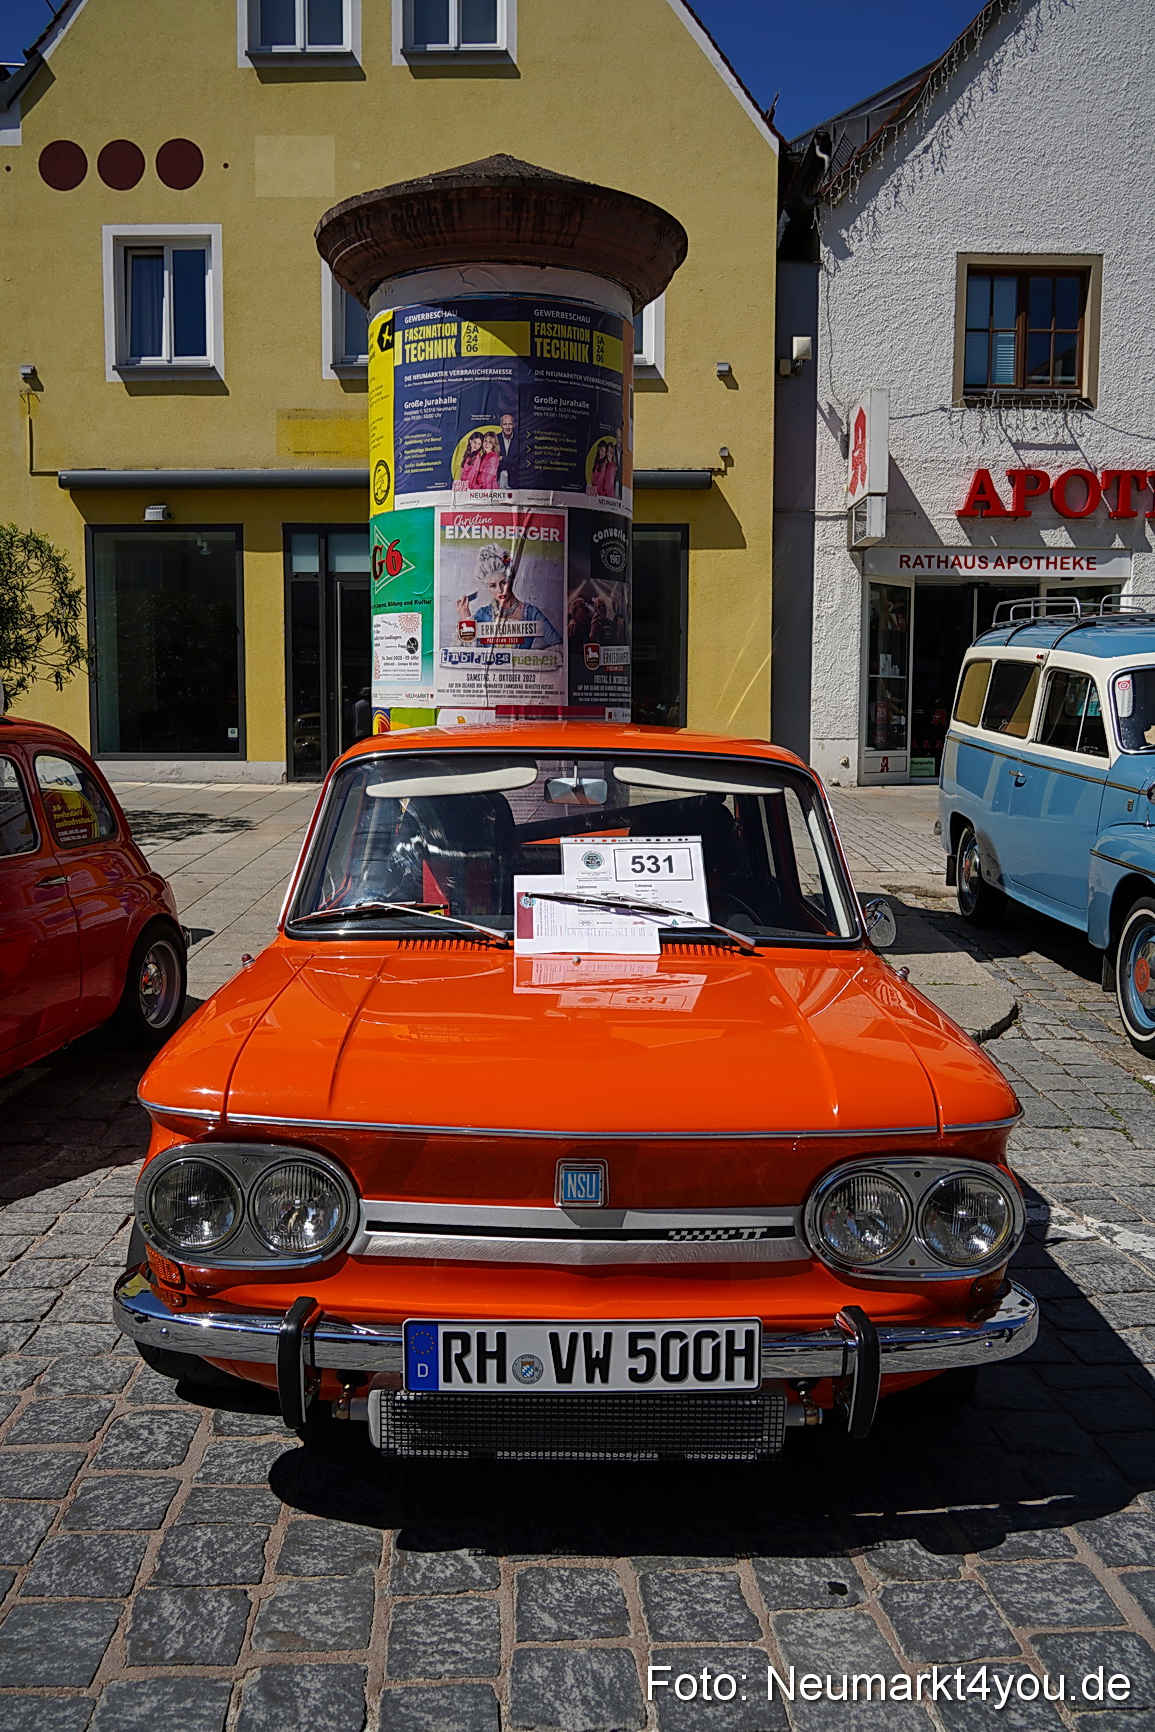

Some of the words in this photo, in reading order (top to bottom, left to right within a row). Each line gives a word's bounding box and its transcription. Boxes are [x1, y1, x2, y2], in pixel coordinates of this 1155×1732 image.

[404, 309, 458, 324] GEWERBESCHAU
[534, 309, 591, 324] GEWERBESCHAU
[404, 322, 458, 343] FASZINATION
[466, 325, 479, 334] SA
[534, 322, 591, 343] FASZINATION
[466, 334, 479, 344] 24
[404, 338, 457, 364] TECHNIK
[466, 344, 479, 352] 06
[534, 338, 590, 364] TECHNIK
[596, 345, 605, 354] 24
[596, 354, 605, 363] 06
[412, 370, 448, 381] NEUMARKTER
[449, 368, 512, 377] VERBRAUCHERMESSE
[546, 370, 583, 381] NEUMARKTER
[404, 400, 424, 409] Große
[424, 396, 457, 408] Jurahalle
[534, 396, 558, 406] Große
[559, 398, 590, 410] Jurahalle
[469, 492, 507, 500] NEUMARKT
[955, 468, 1155, 519] APOT
[453, 514, 494, 527] Christine
[445, 524, 560, 542] EIXENBERGER
[371, 538, 404, 582] G6
[898, 553, 989, 571] RATHAUS
[992, 554, 1098, 572] APOTHEKE
[413, 598, 432, 606] Kultur
[481, 622, 538, 636] ERNTEDANKFEST
[499, 674, 521, 682] OKTOBER
[630, 854, 674, 874] 531
[567, 1173, 597, 1199] NSU
[738, 1228, 768, 1241] TT
[442, 1331, 508, 1384] RH
[548, 1331, 613, 1384] VW
[627, 1329, 756, 1384] 500H
[416, 1362, 430, 1379] D
